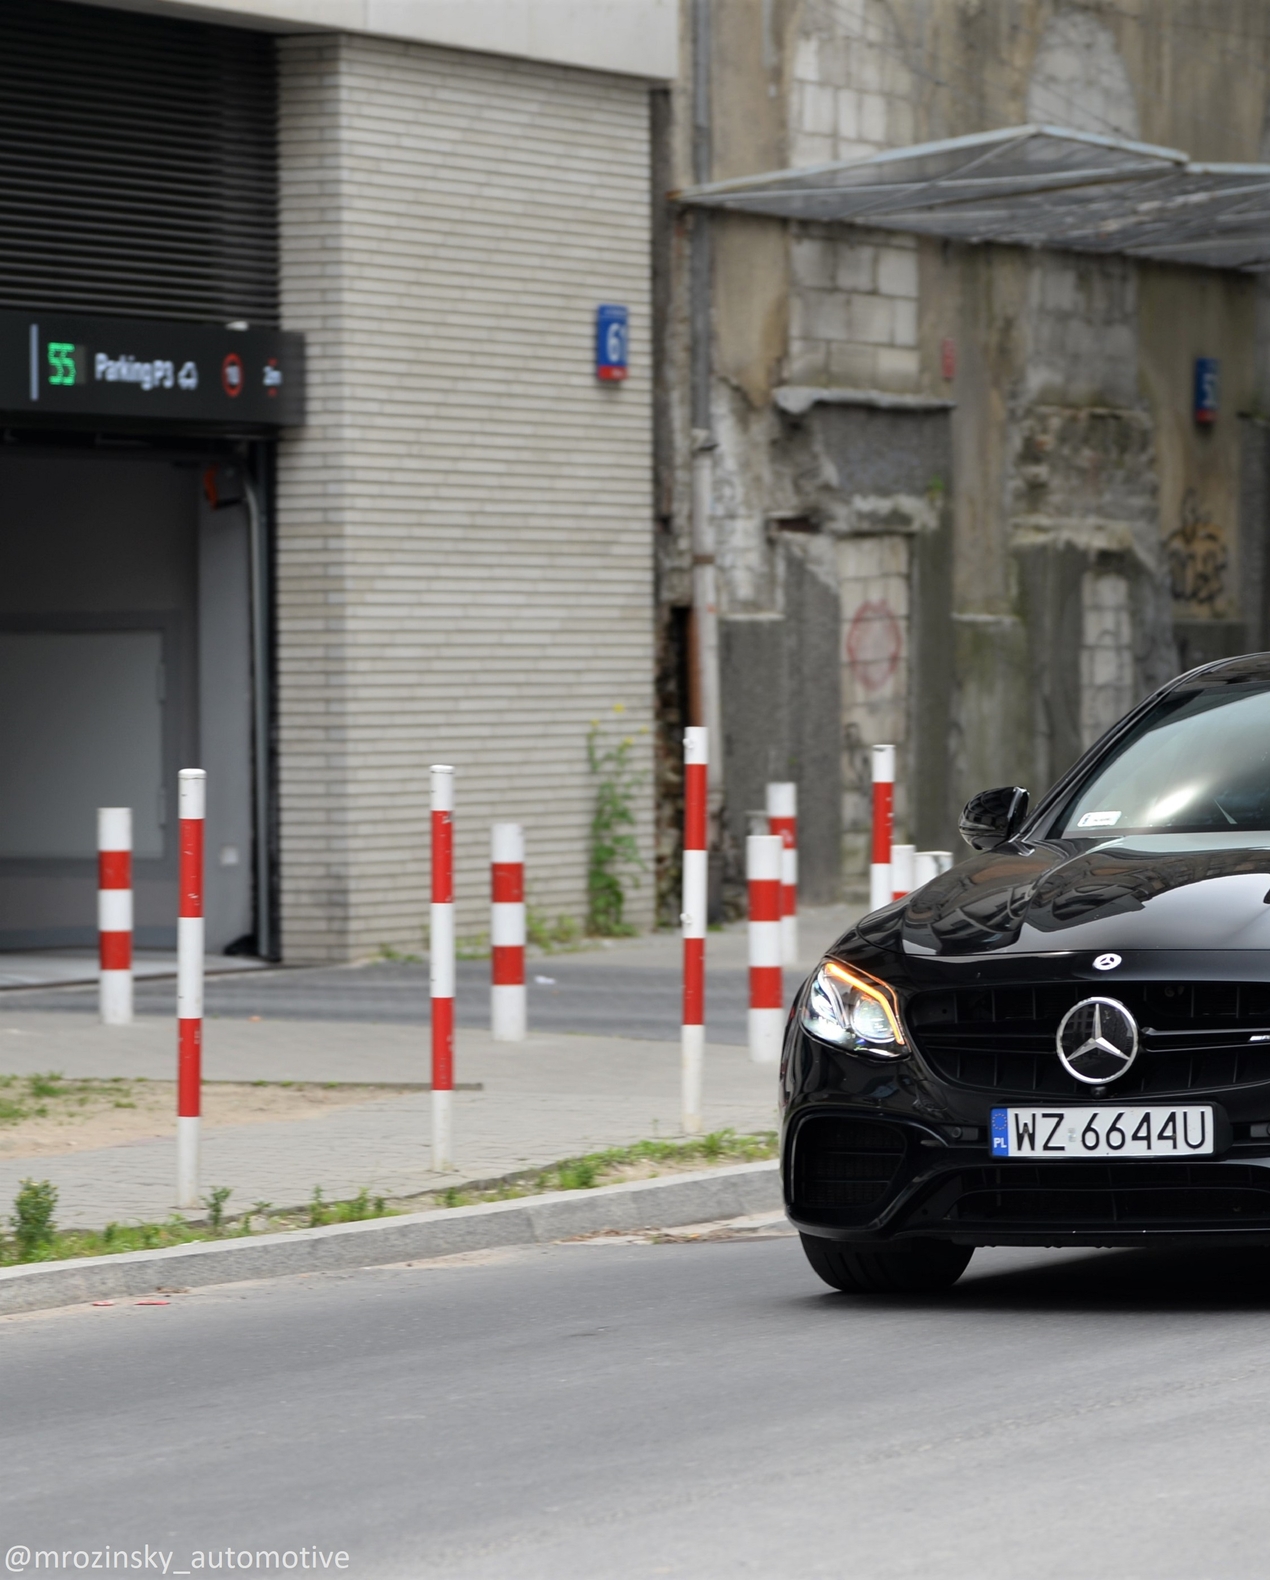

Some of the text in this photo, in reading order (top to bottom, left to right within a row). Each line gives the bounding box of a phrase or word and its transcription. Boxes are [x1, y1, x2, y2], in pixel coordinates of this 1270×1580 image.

[48, 342, 75, 385] 55
[993, 1137, 1008, 1148] PL
[1014, 1110, 1205, 1151] WZ 6644U
